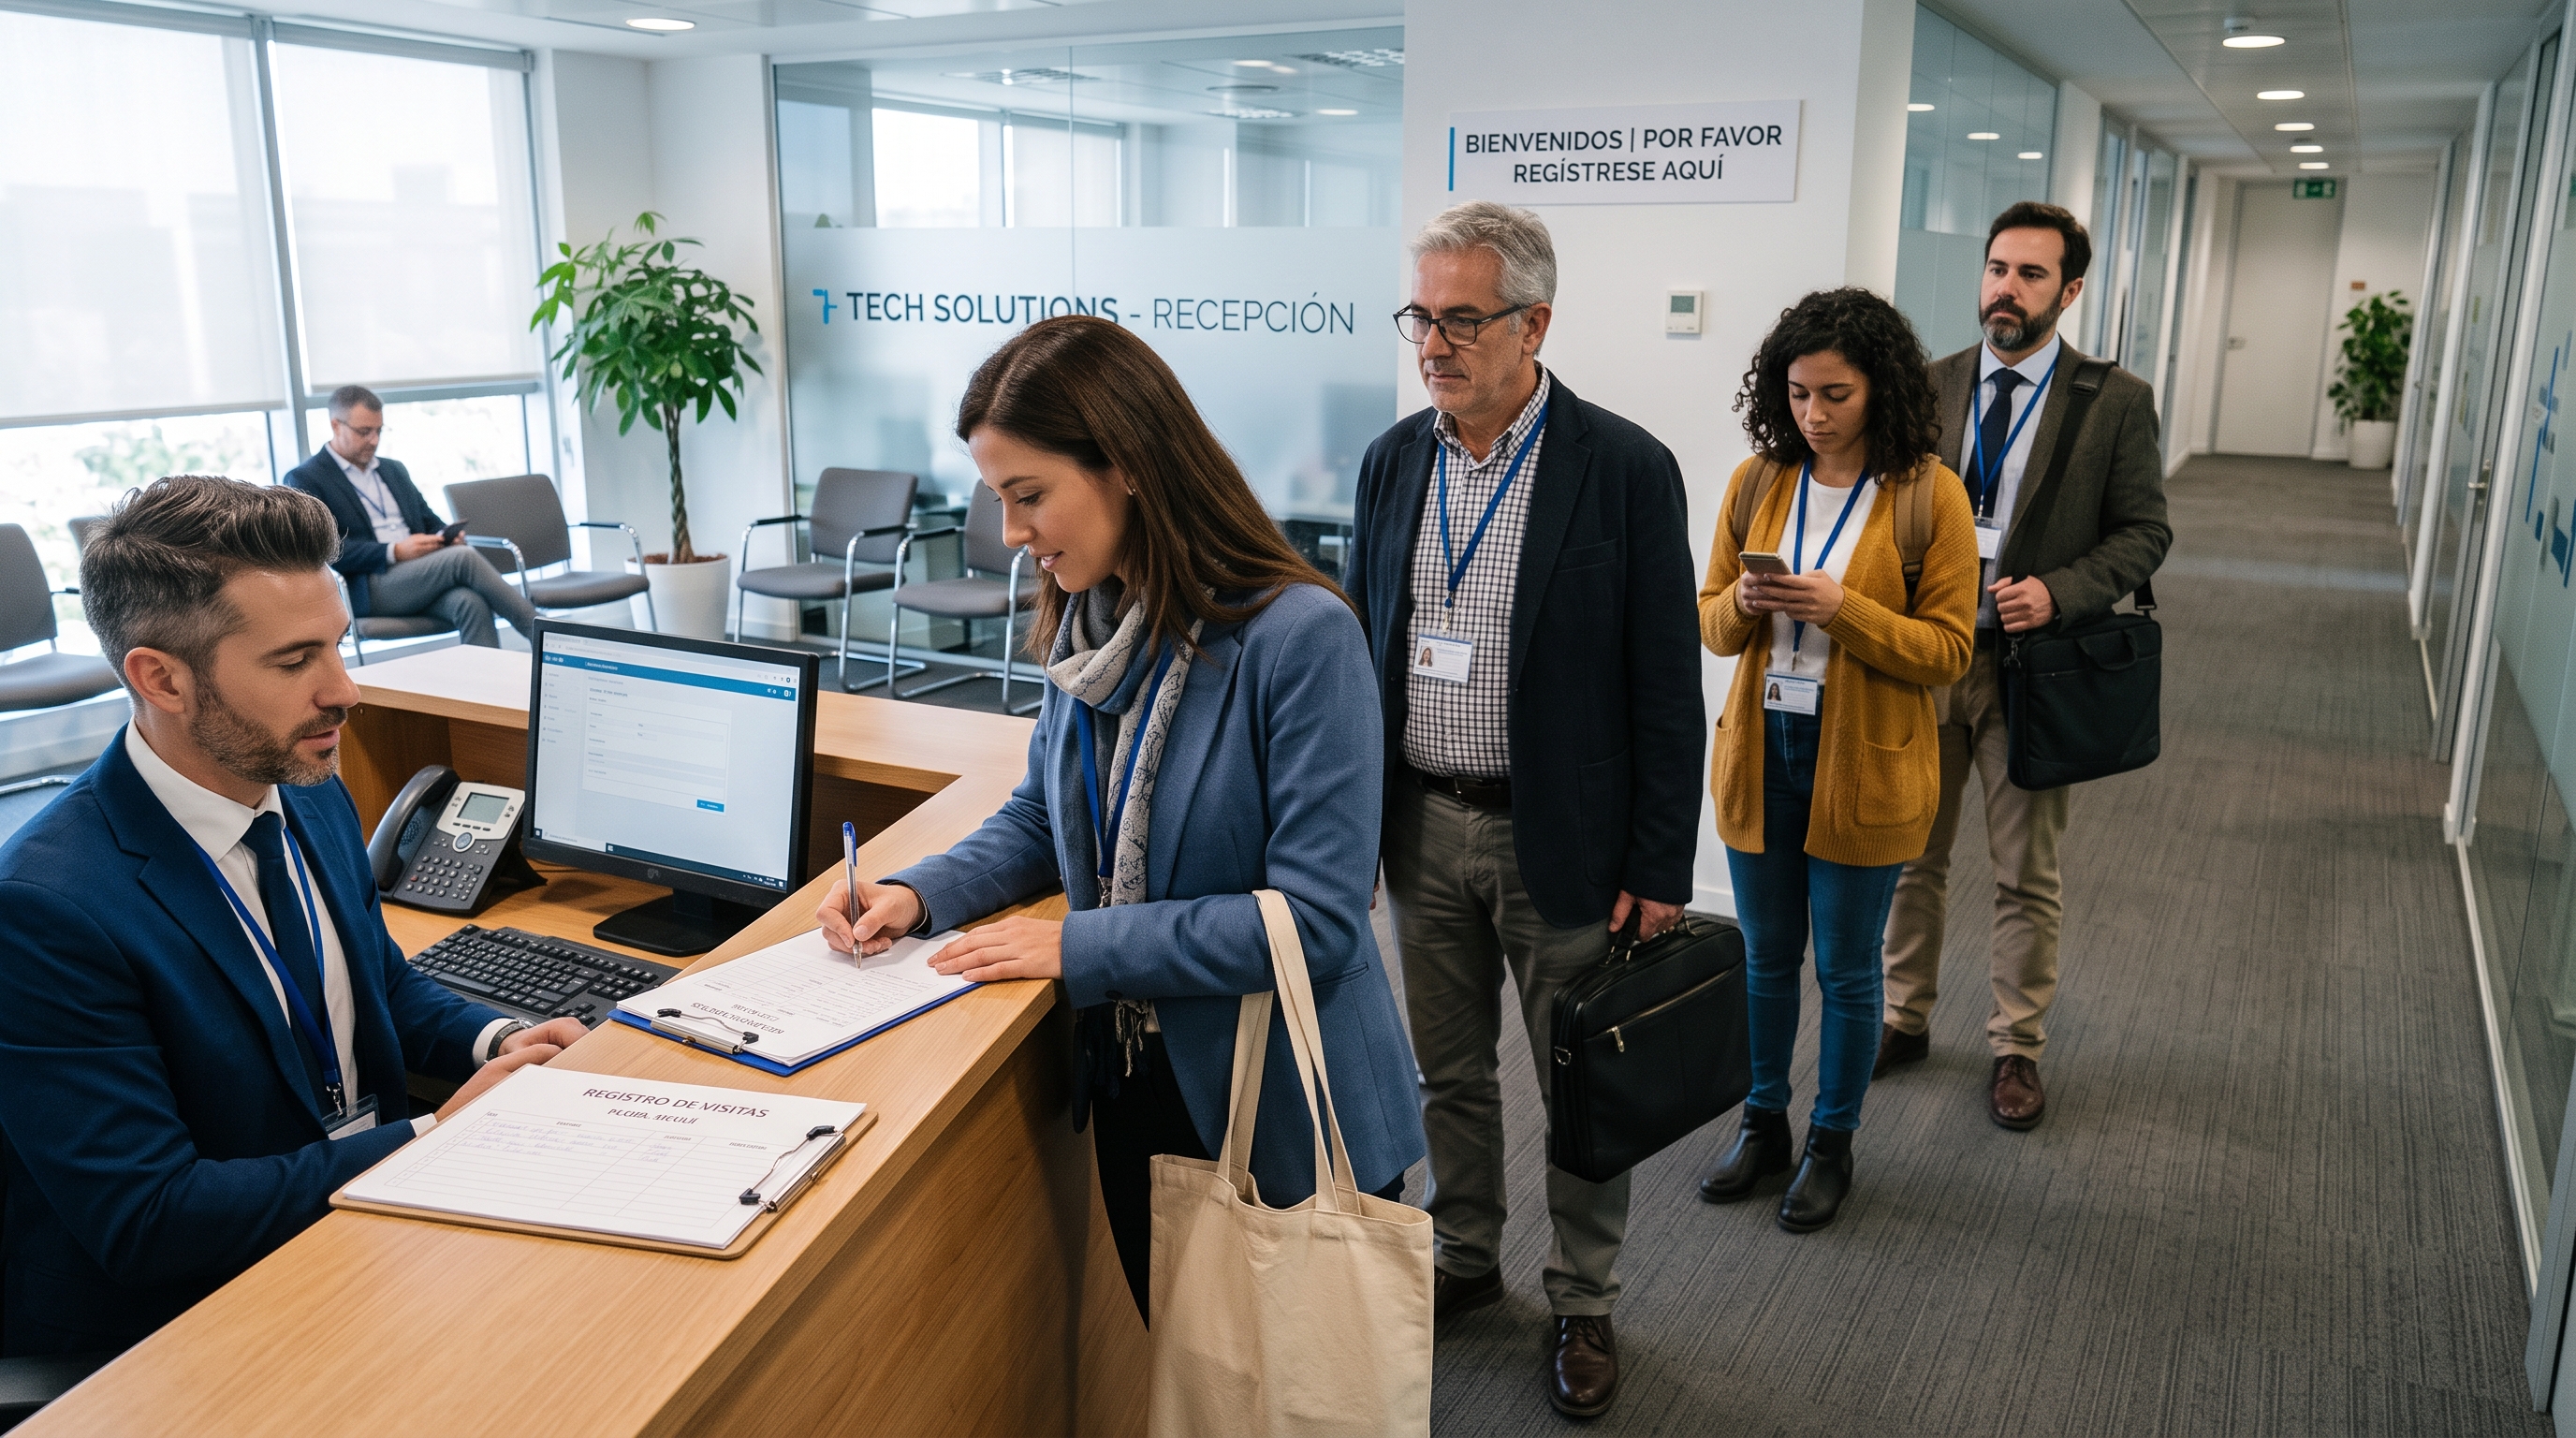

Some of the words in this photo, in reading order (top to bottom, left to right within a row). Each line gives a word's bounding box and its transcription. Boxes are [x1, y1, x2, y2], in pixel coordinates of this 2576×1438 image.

[1465, 130, 1623, 154] BIENVENIDOS
[1643, 127, 1693, 149] POR
[1701, 125, 1783, 147] FAVOR
[1514, 157, 1656, 183] REGÍSTRESE
[1662, 154, 1724, 182] AQUÍ
[846, 292, 924, 321] TECH
[934, 294, 1119, 325] SOLUTIONS
[1154, 292, 1354, 334] RECEPCIÓN
[582, 1088, 670, 1106] REGISTRO
[672, 1099, 699, 1109] DE
[698, 1102, 770, 1118] VISITAS
